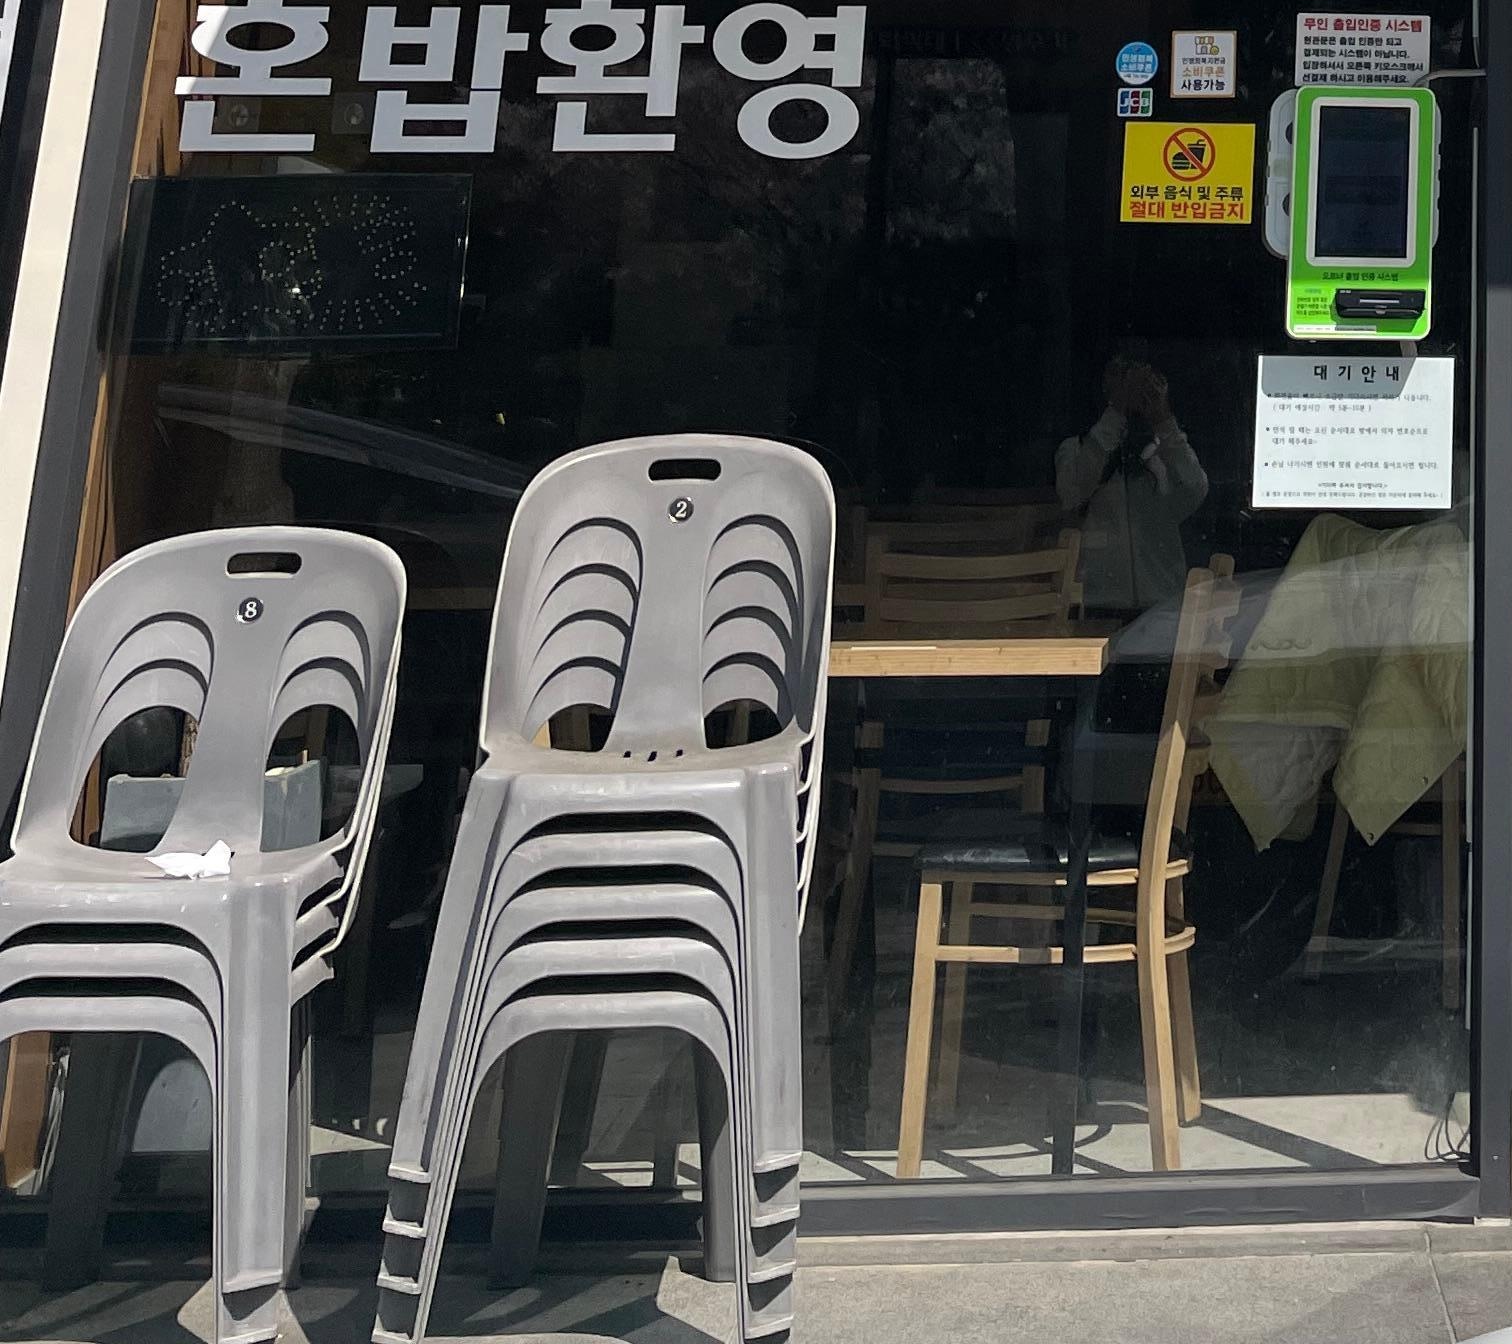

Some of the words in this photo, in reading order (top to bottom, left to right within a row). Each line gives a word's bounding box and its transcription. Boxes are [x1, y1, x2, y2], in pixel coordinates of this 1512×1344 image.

[1304, 18, 1328, 31] 무인
[1385, 19, 1422, 32] 시스템
[1181, 79, 1226, 91] 사용가능
[1130, 185, 1159, 199] 외부
[1164, 185, 1192, 200] 음식
[1197, 186, 1211, 200] 및
[1215, 186, 1243, 201] 주류
[1130, 201, 1165, 218] 절대
[1171, 202, 1244, 219] 반입금지
[676, 502, 687, 518] 2
[245, 601, 257, 619] 8
